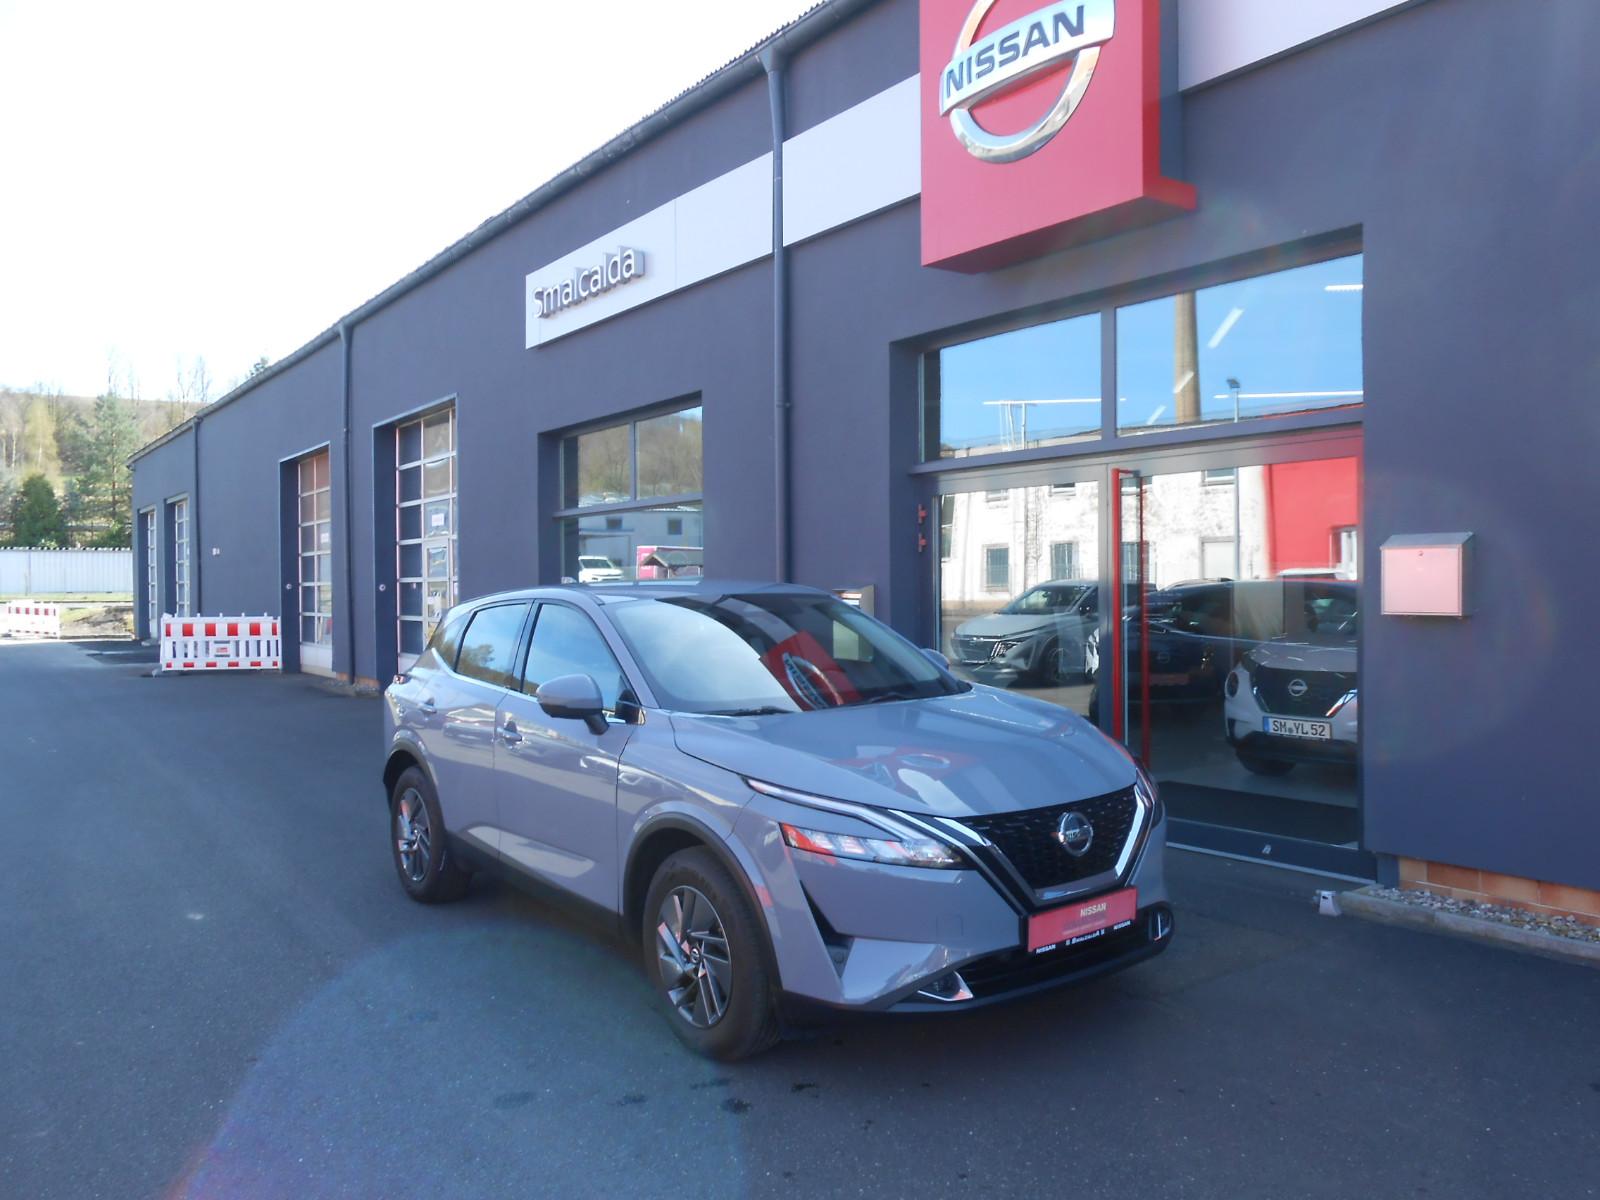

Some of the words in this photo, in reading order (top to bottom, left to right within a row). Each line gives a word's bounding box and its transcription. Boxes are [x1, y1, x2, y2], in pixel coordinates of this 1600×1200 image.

[945, 5, 1085, 99] NISSAN
[533, 246, 644, 319] Smalcalda
[1272, 720, 1288, 733] SM
[1294, 722, 1308, 735] YL
[1310, 724, 1326, 737] 52
[1080, 903, 1107, 917] NISSAN
